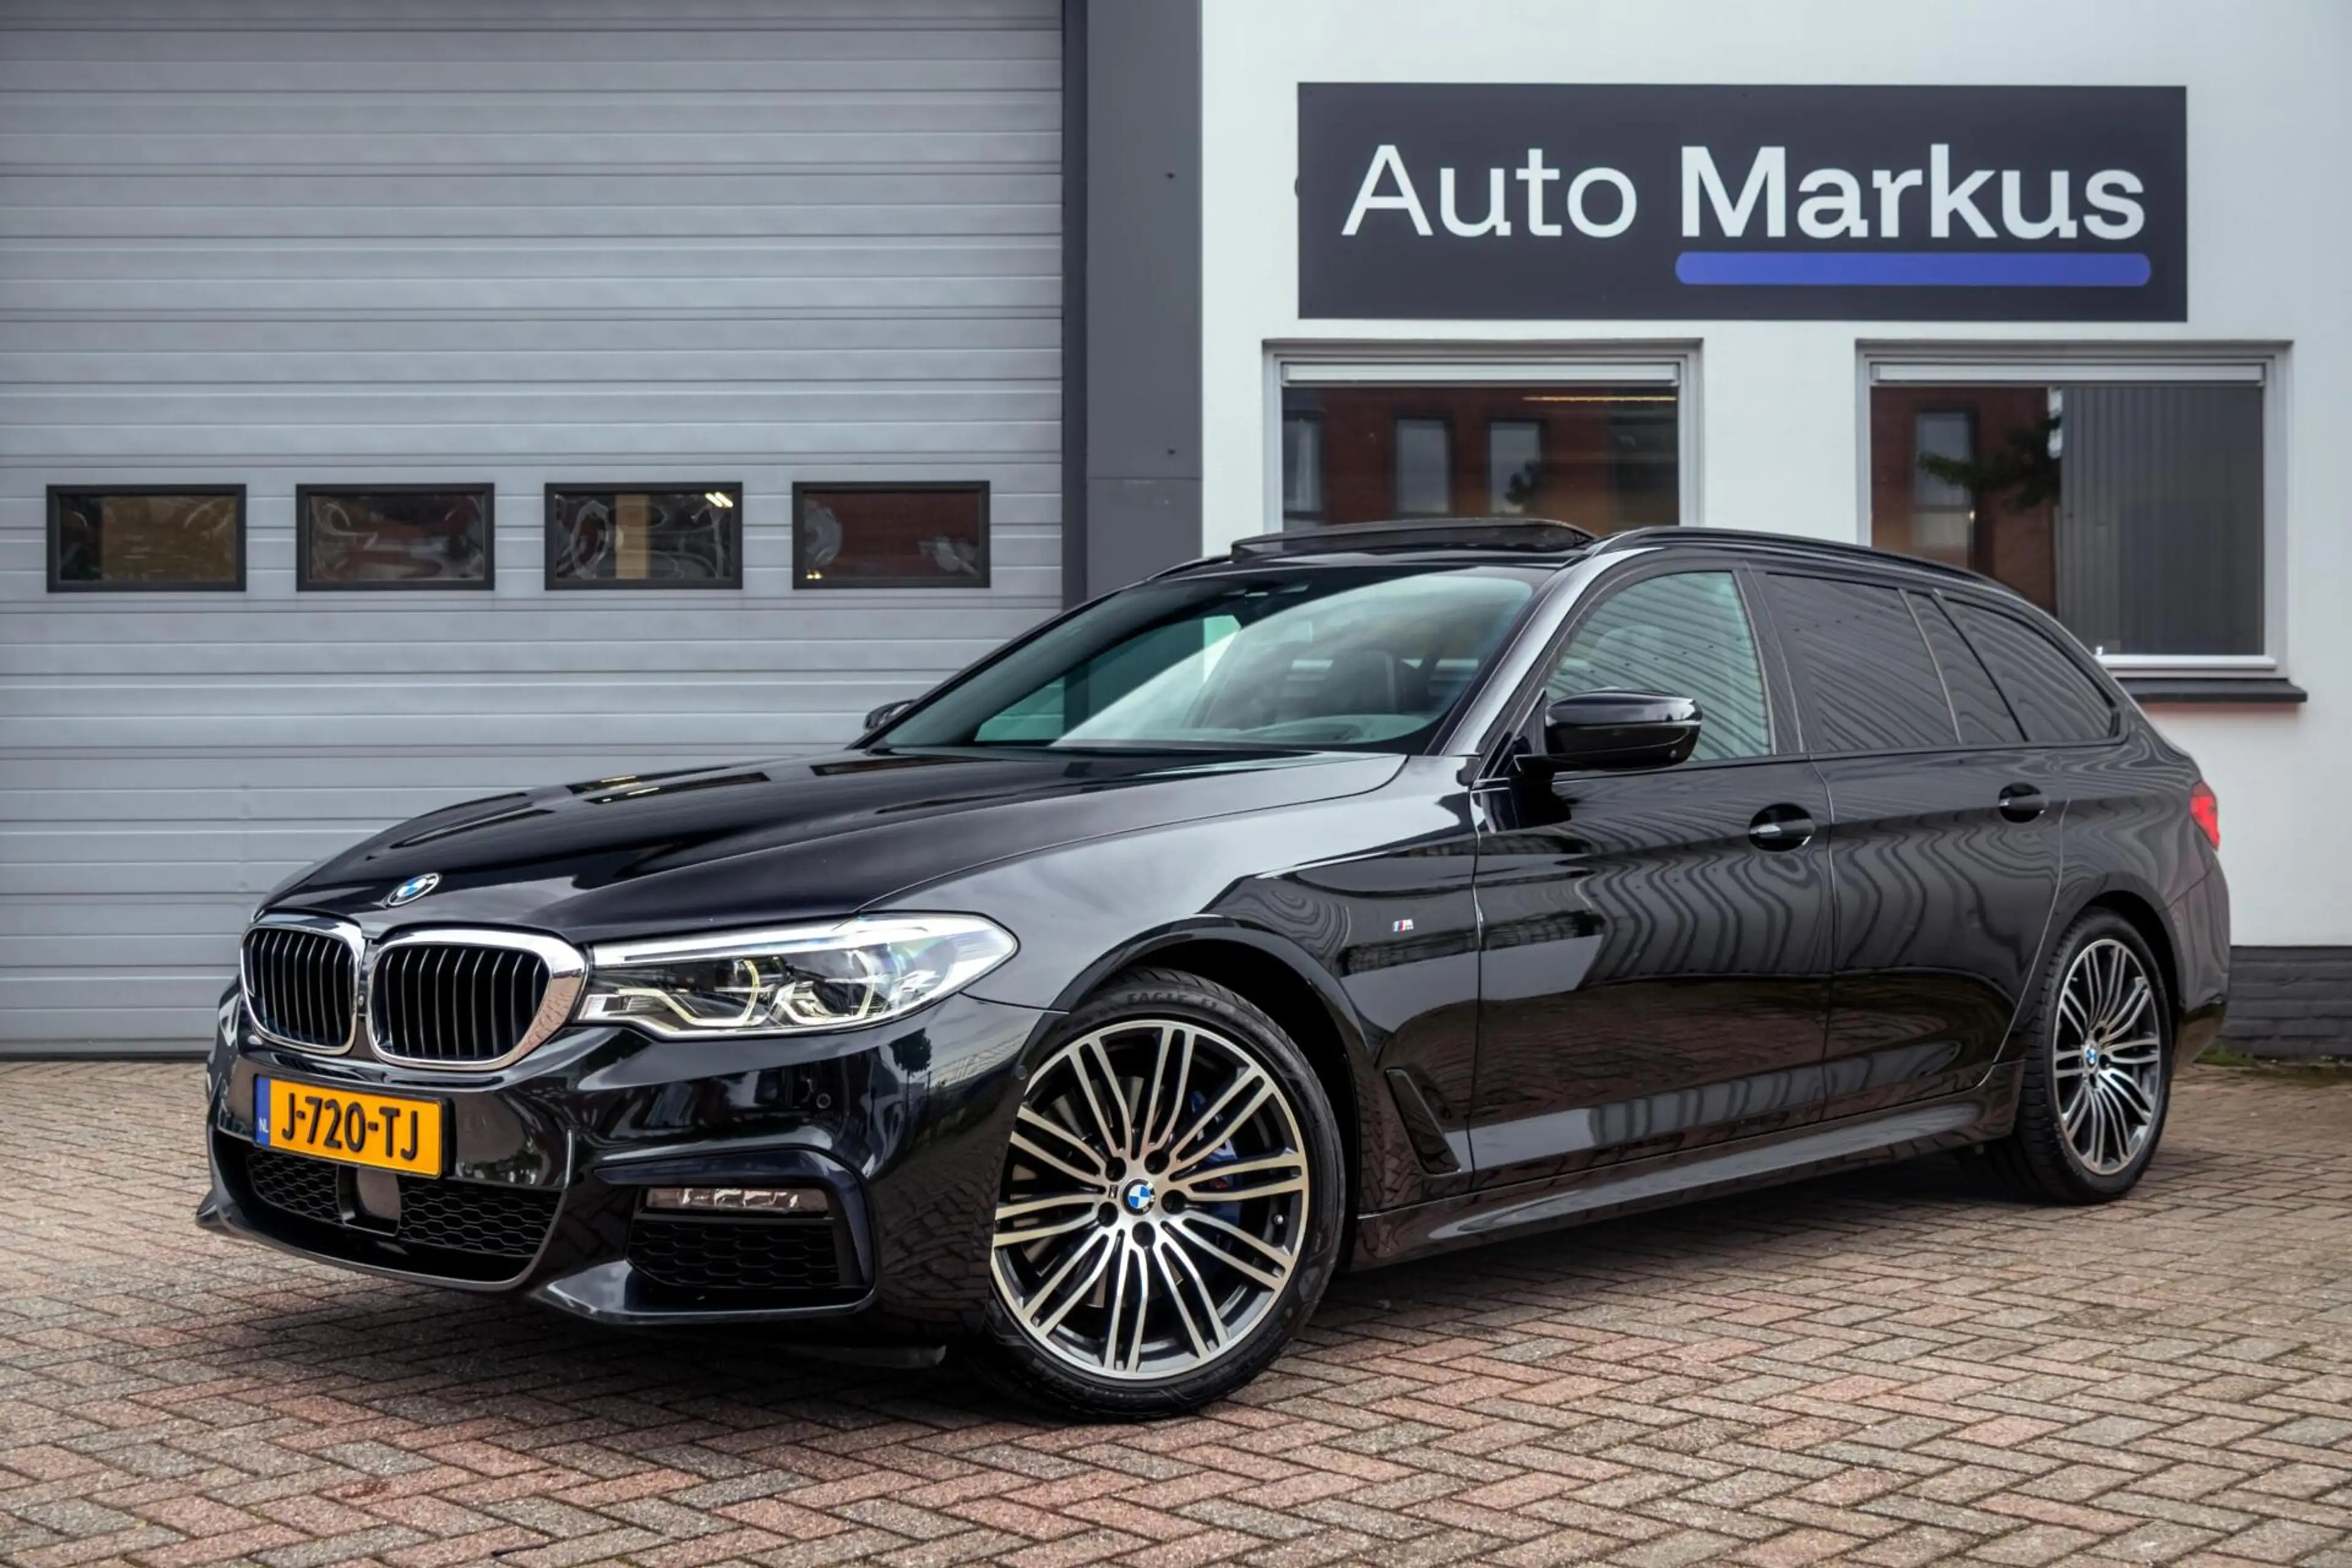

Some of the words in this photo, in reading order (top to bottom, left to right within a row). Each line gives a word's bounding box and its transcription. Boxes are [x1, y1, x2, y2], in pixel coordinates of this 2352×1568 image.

[1342, 145, 1637, 238] Auto
[1681, 144, 2144, 239] Markus
[258, 1117, 270, 1133] NL
[281, 1092, 418, 1161] J-720-TJ
